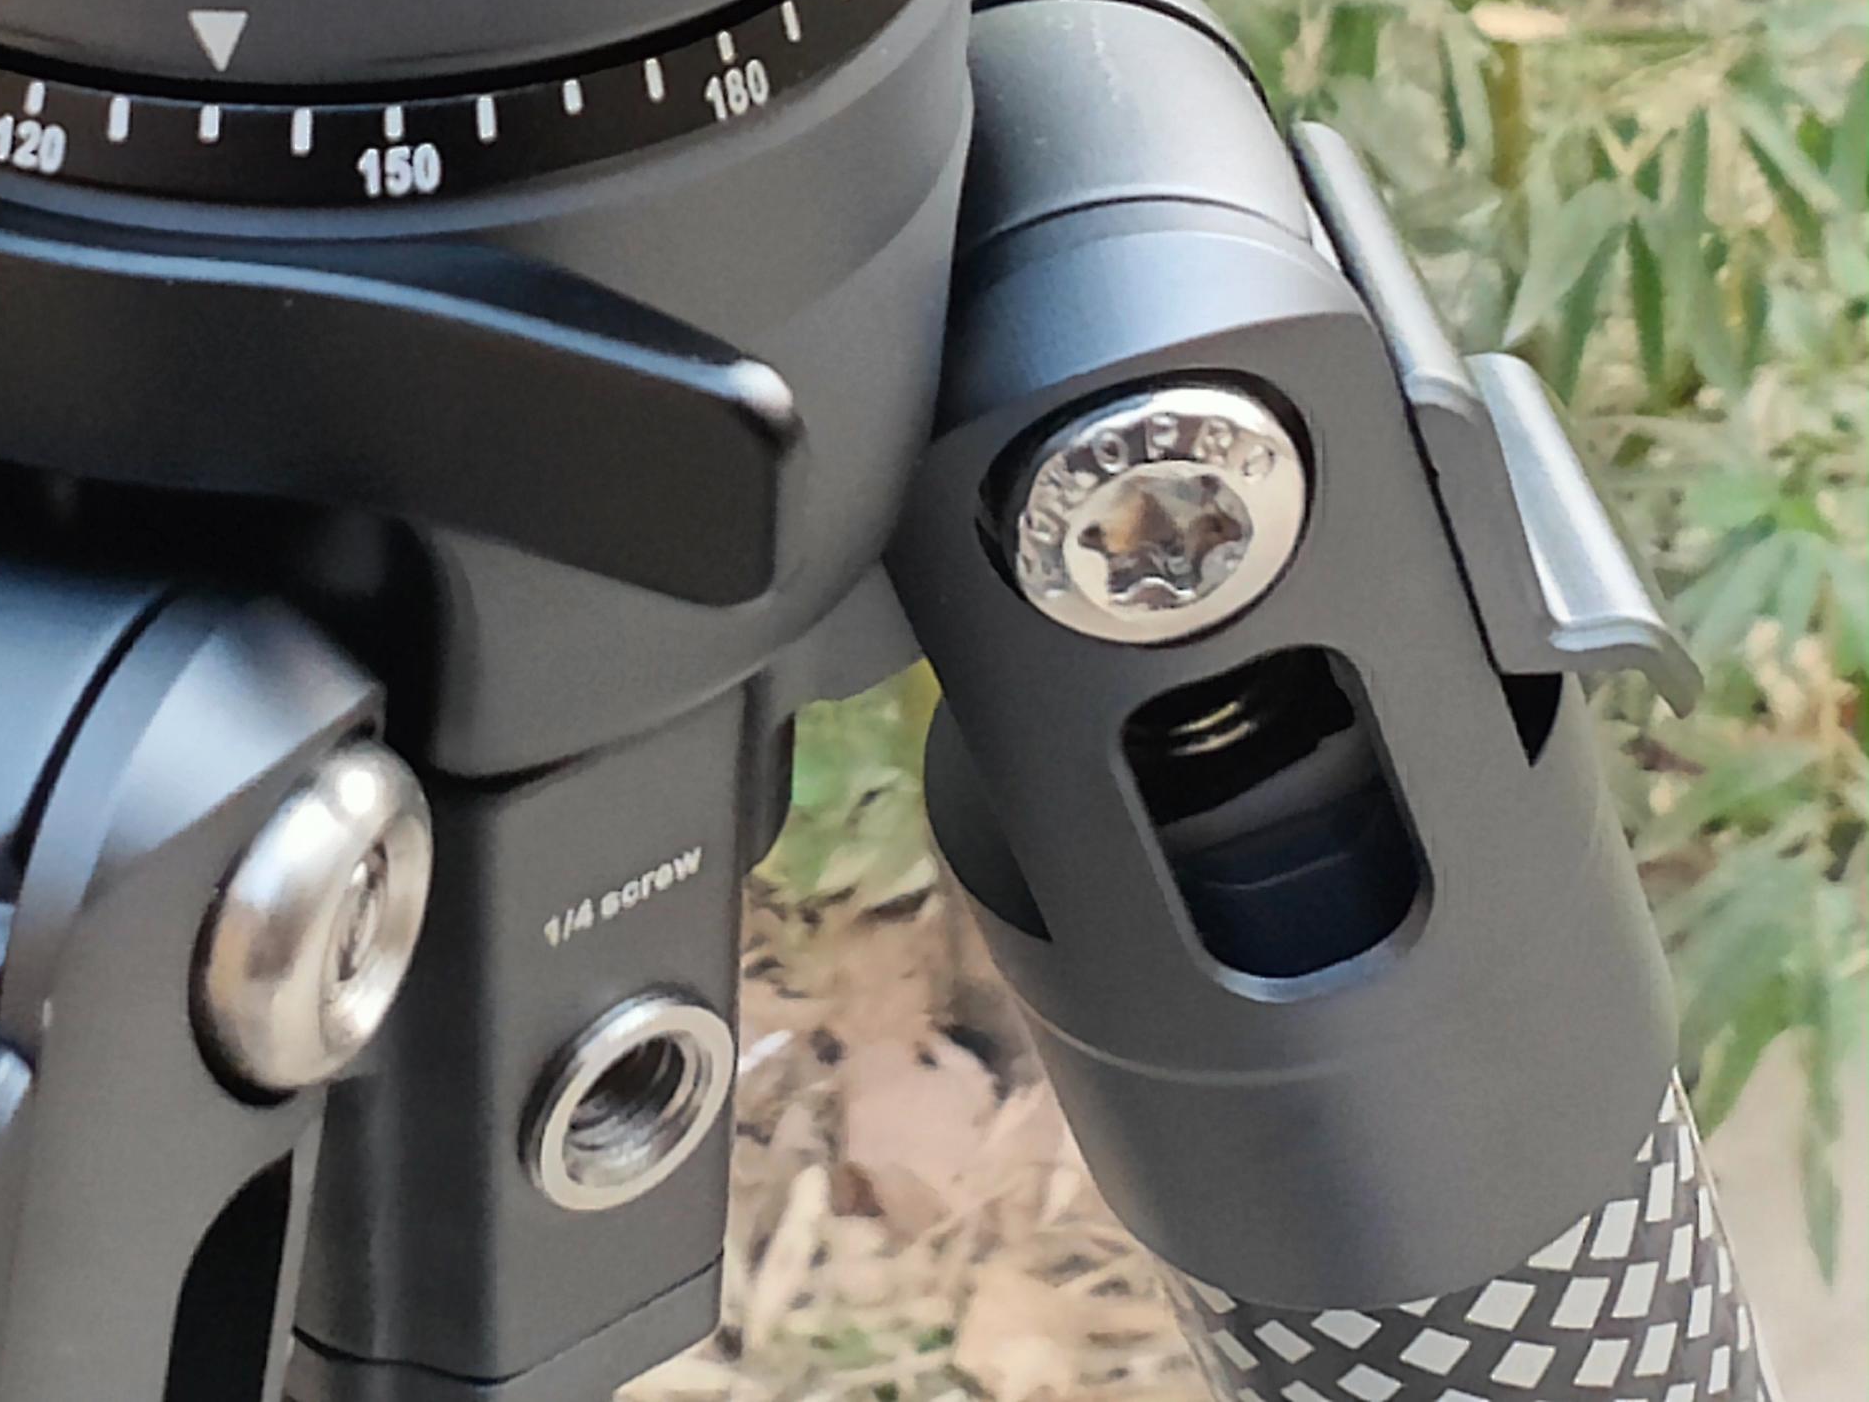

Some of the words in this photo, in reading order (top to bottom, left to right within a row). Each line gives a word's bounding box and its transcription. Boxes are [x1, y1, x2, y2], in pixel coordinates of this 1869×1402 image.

[705, 58, 769, 120] 180
[356, 142, 443, 198] 150
[599, 846, 703, 921] screw
